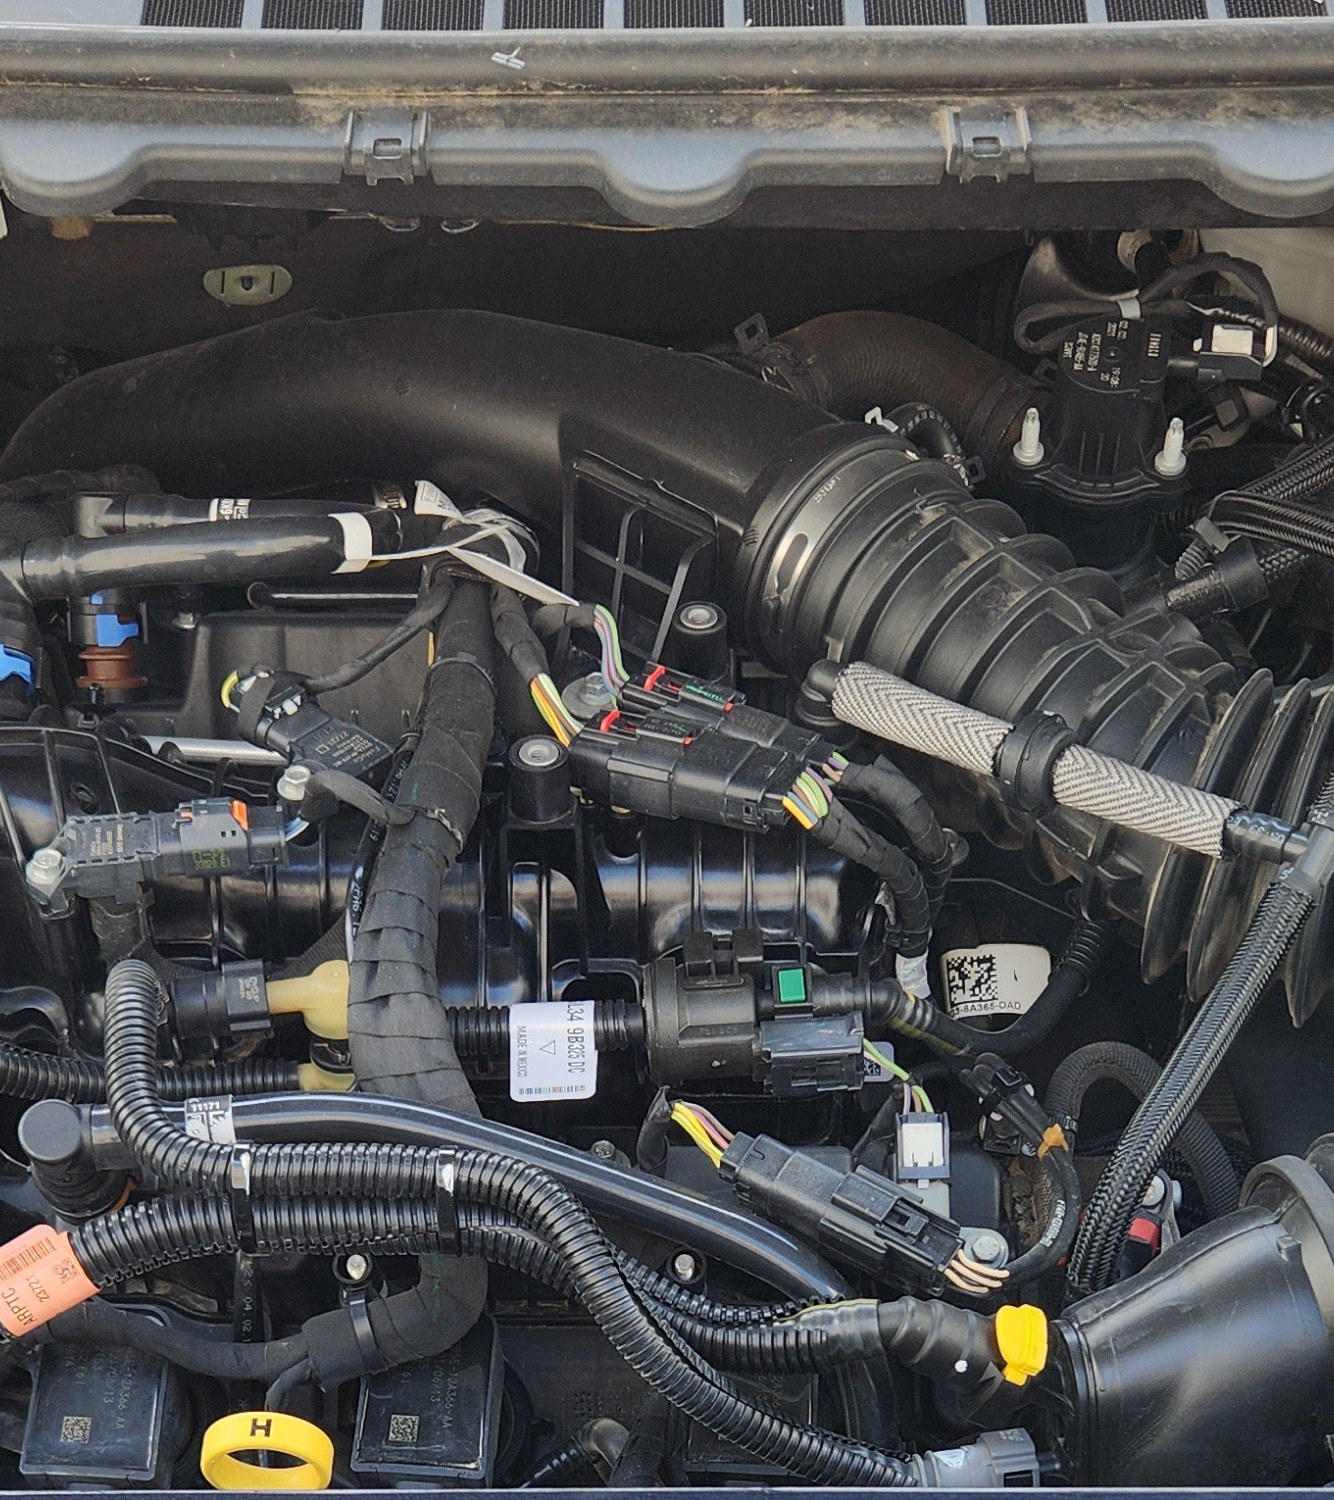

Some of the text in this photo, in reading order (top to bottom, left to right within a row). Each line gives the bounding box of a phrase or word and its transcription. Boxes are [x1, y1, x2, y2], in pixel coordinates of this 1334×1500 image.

[517, 1025, 527, 1048] MADE
[190, 1101, 220, 1111] 11171
[25, 1275, 51, 1303] 23721
[1, 1287, 37, 1326] ARPTC
[249, 1418, 273, 1437] H
